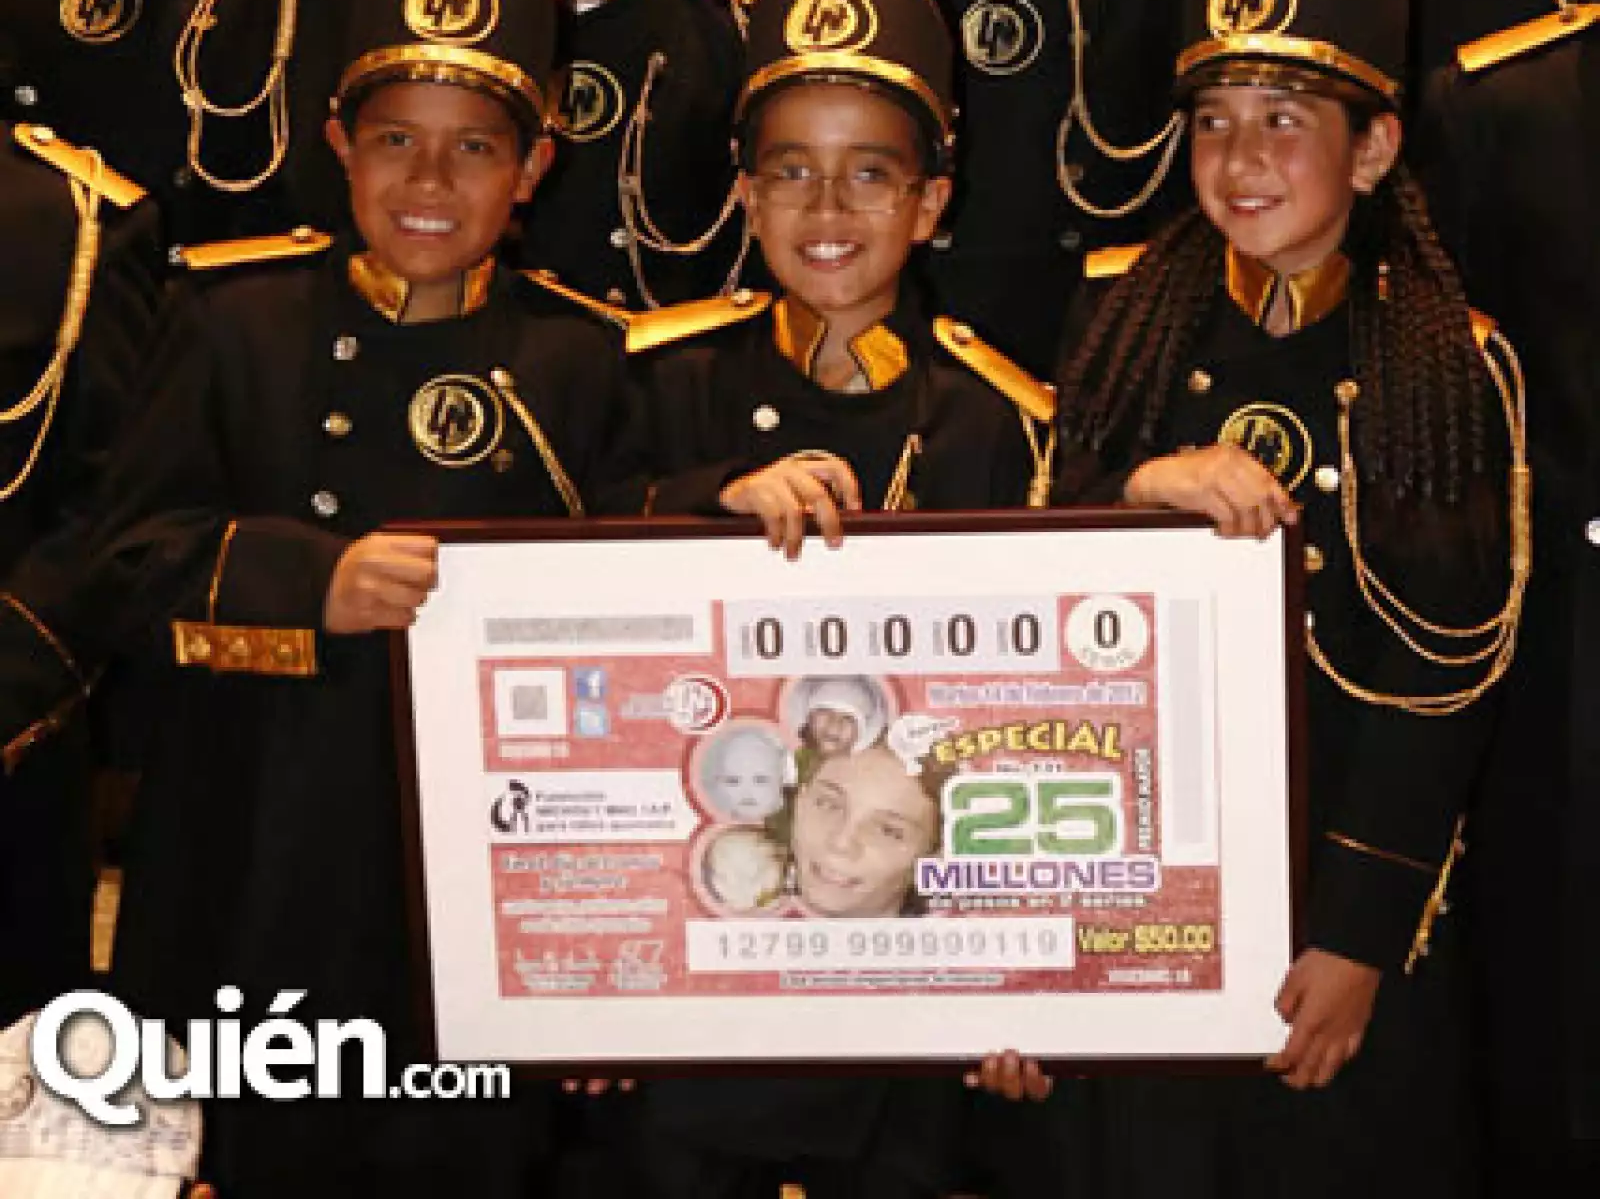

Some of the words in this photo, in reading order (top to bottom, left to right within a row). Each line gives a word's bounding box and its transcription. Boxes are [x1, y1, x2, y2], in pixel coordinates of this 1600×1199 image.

[934, 718, 1123, 766] ESPECIAL
[950, 779, 1119, 856] 25
[920, 859, 1156, 889] MILLONES
